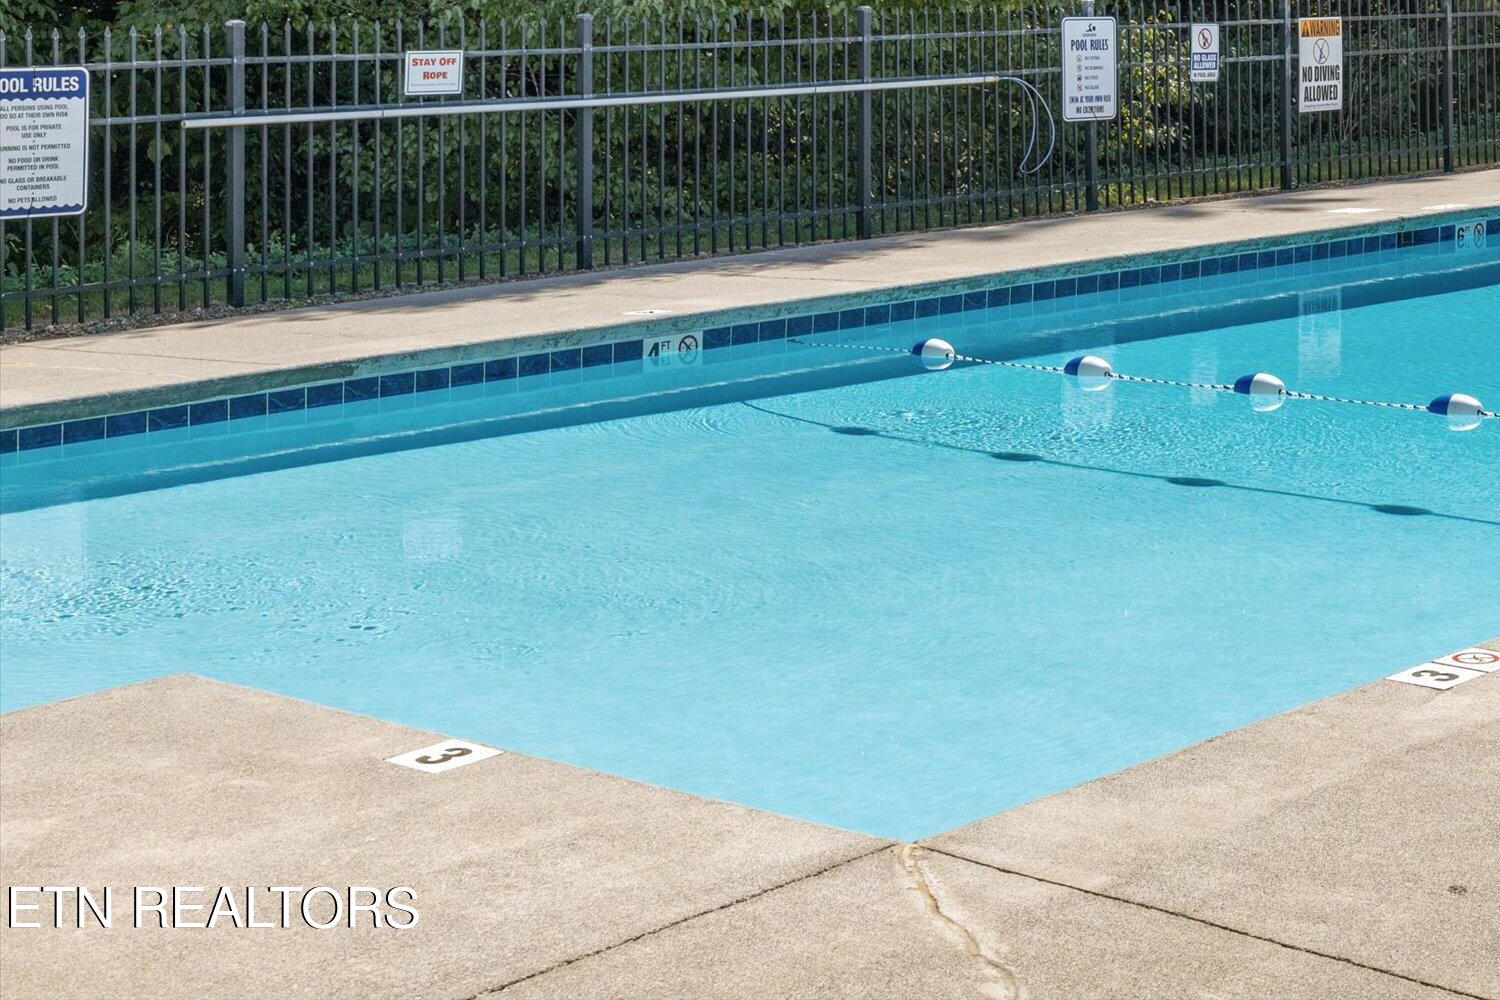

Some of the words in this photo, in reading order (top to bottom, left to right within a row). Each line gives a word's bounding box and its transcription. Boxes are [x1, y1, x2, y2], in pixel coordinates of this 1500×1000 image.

[1310, 20, 1340, 36] WARNING
[1071, 39, 1088, 51] POOL
[1090, 38, 1108, 51] RULES
[412, 58, 436, 66] STAY
[440, 58, 457, 66] OFF
[422, 72, 448, 80] ROPE
[1302, 66, 1312, 82] NO
[1314, 64, 1340, 81] DIVING
[0, 78, 28, 93] OOL
[33, 76, 80, 92] RULES
[1304, 84, 1338, 102] ALLOWED
[648, 342, 660, 356] 4
[661, 341, 670, 350] FT
[1412, 670, 1460, 682] 3
[415, 748, 472, 764] 3
